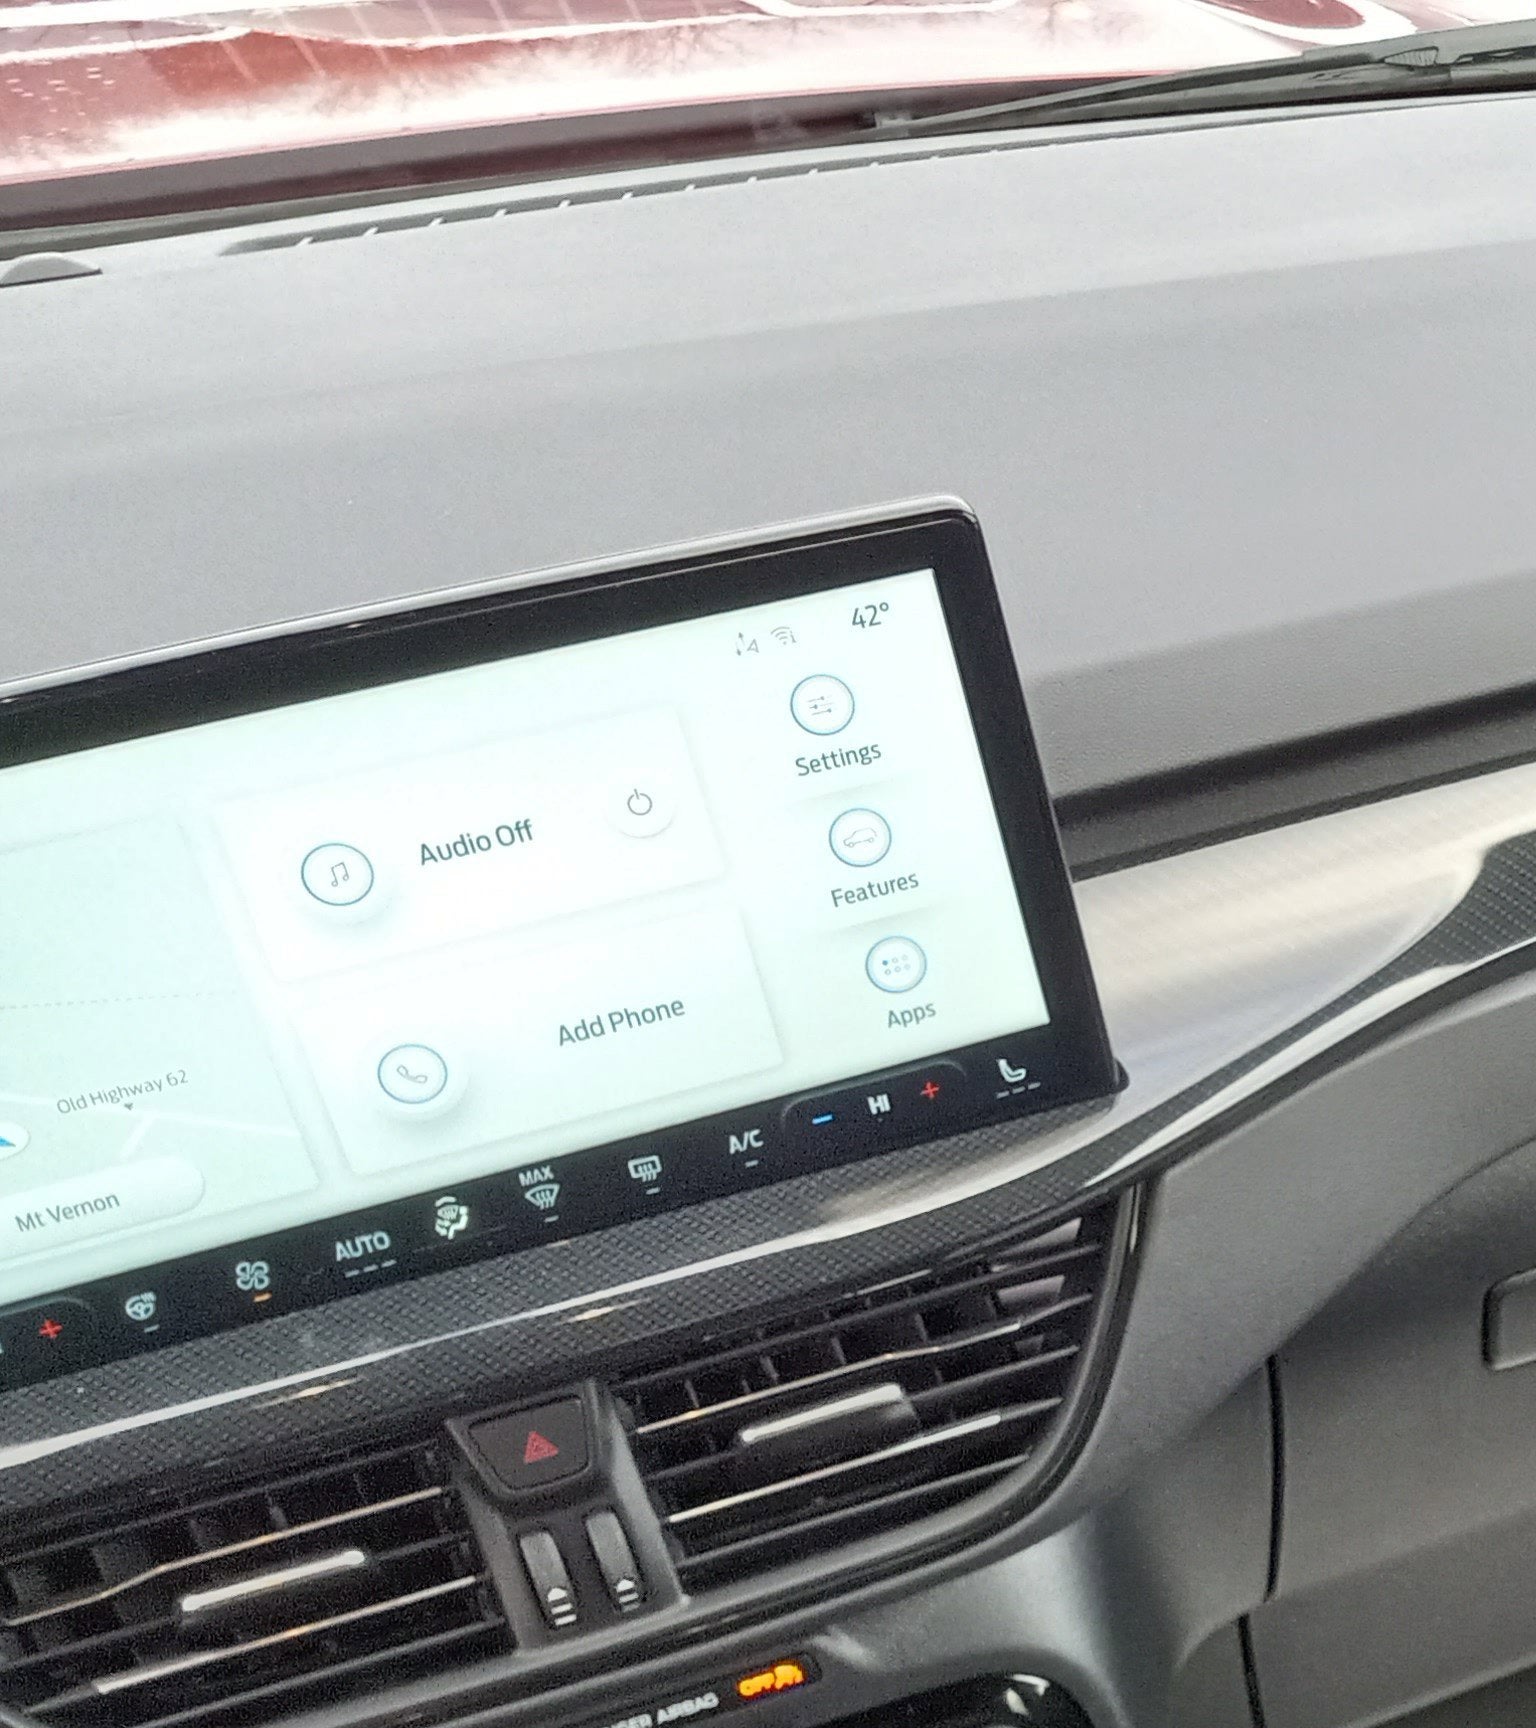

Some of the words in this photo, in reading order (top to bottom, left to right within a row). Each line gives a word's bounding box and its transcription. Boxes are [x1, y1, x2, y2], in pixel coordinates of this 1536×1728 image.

[795, 743, 882, 777] Settings
[420, 833, 492, 866] Audio
[495, 818, 533, 847] Off
[830, 873, 919, 908] Features
[558, 1015, 606, 1047] Add
[608, 999, 686, 1033] Phone
[887, 1003, 937, 1029] Apps
[56, 1095, 89, 1115] Old
[89, 1078, 164, 1105] Highway
[165, 1069, 189, 1088] 62
[728, 1128, 764, 1154] A/C
[518, 1164, 554, 1187] MAX
[14, 1211, 46, 1232] Mt
[45, 1193, 121, 1223] Vernon
[334, 1230, 391, 1262] AUTO
[656, 1691, 720, 1725] AIRBAG
